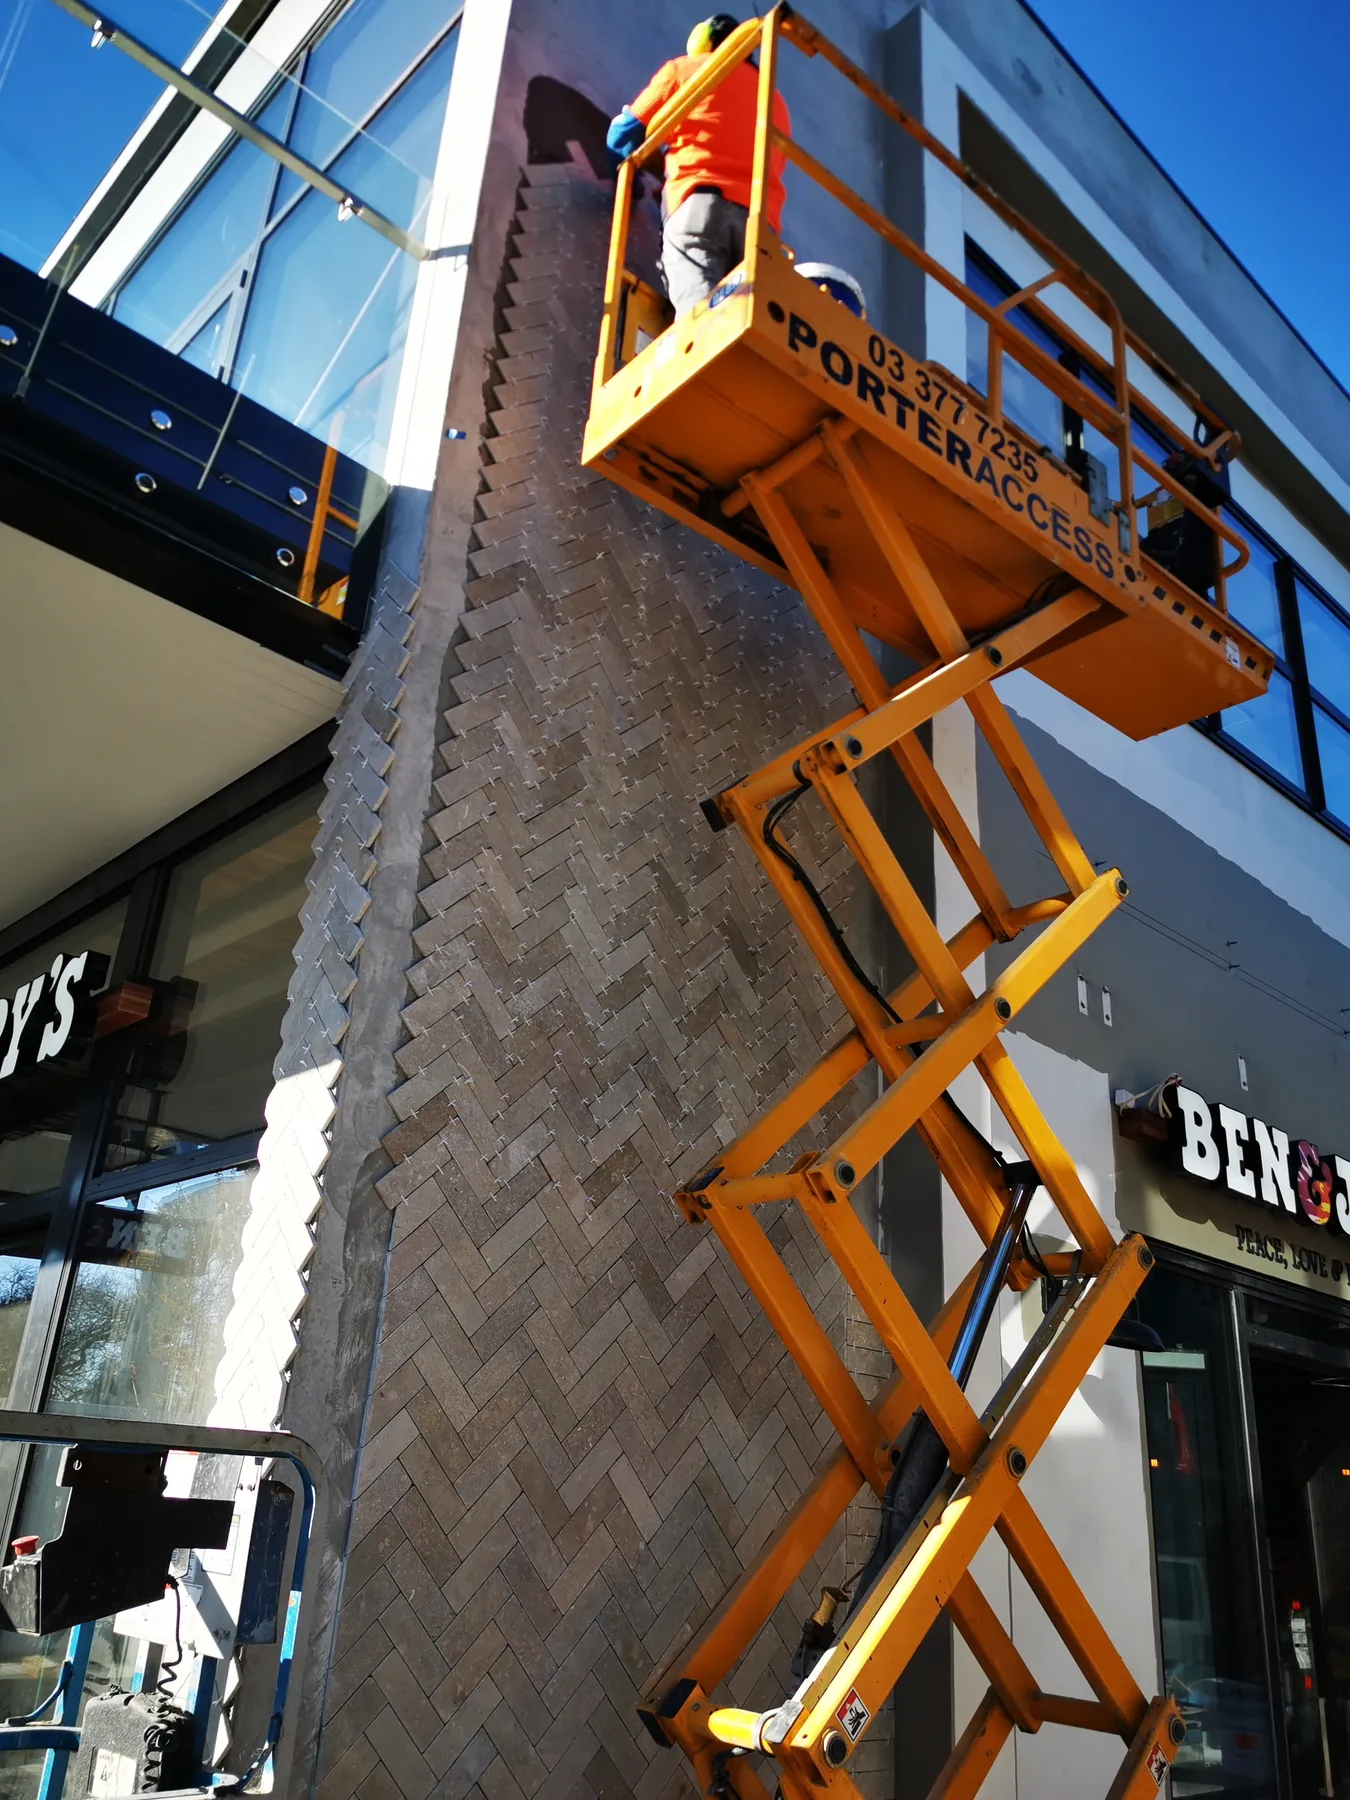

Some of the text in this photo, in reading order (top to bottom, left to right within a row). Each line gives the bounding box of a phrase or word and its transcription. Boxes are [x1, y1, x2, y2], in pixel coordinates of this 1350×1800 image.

[868, 334, 1039, 483] 03 377 7235
[0, 951, 88, 1079] Y'S
[1177, 1085, 1297, 1214] BEN
[1234, 1223, 1288, 1270] PEACE,
[1290, 1242, 1328, 1278] LOVE
